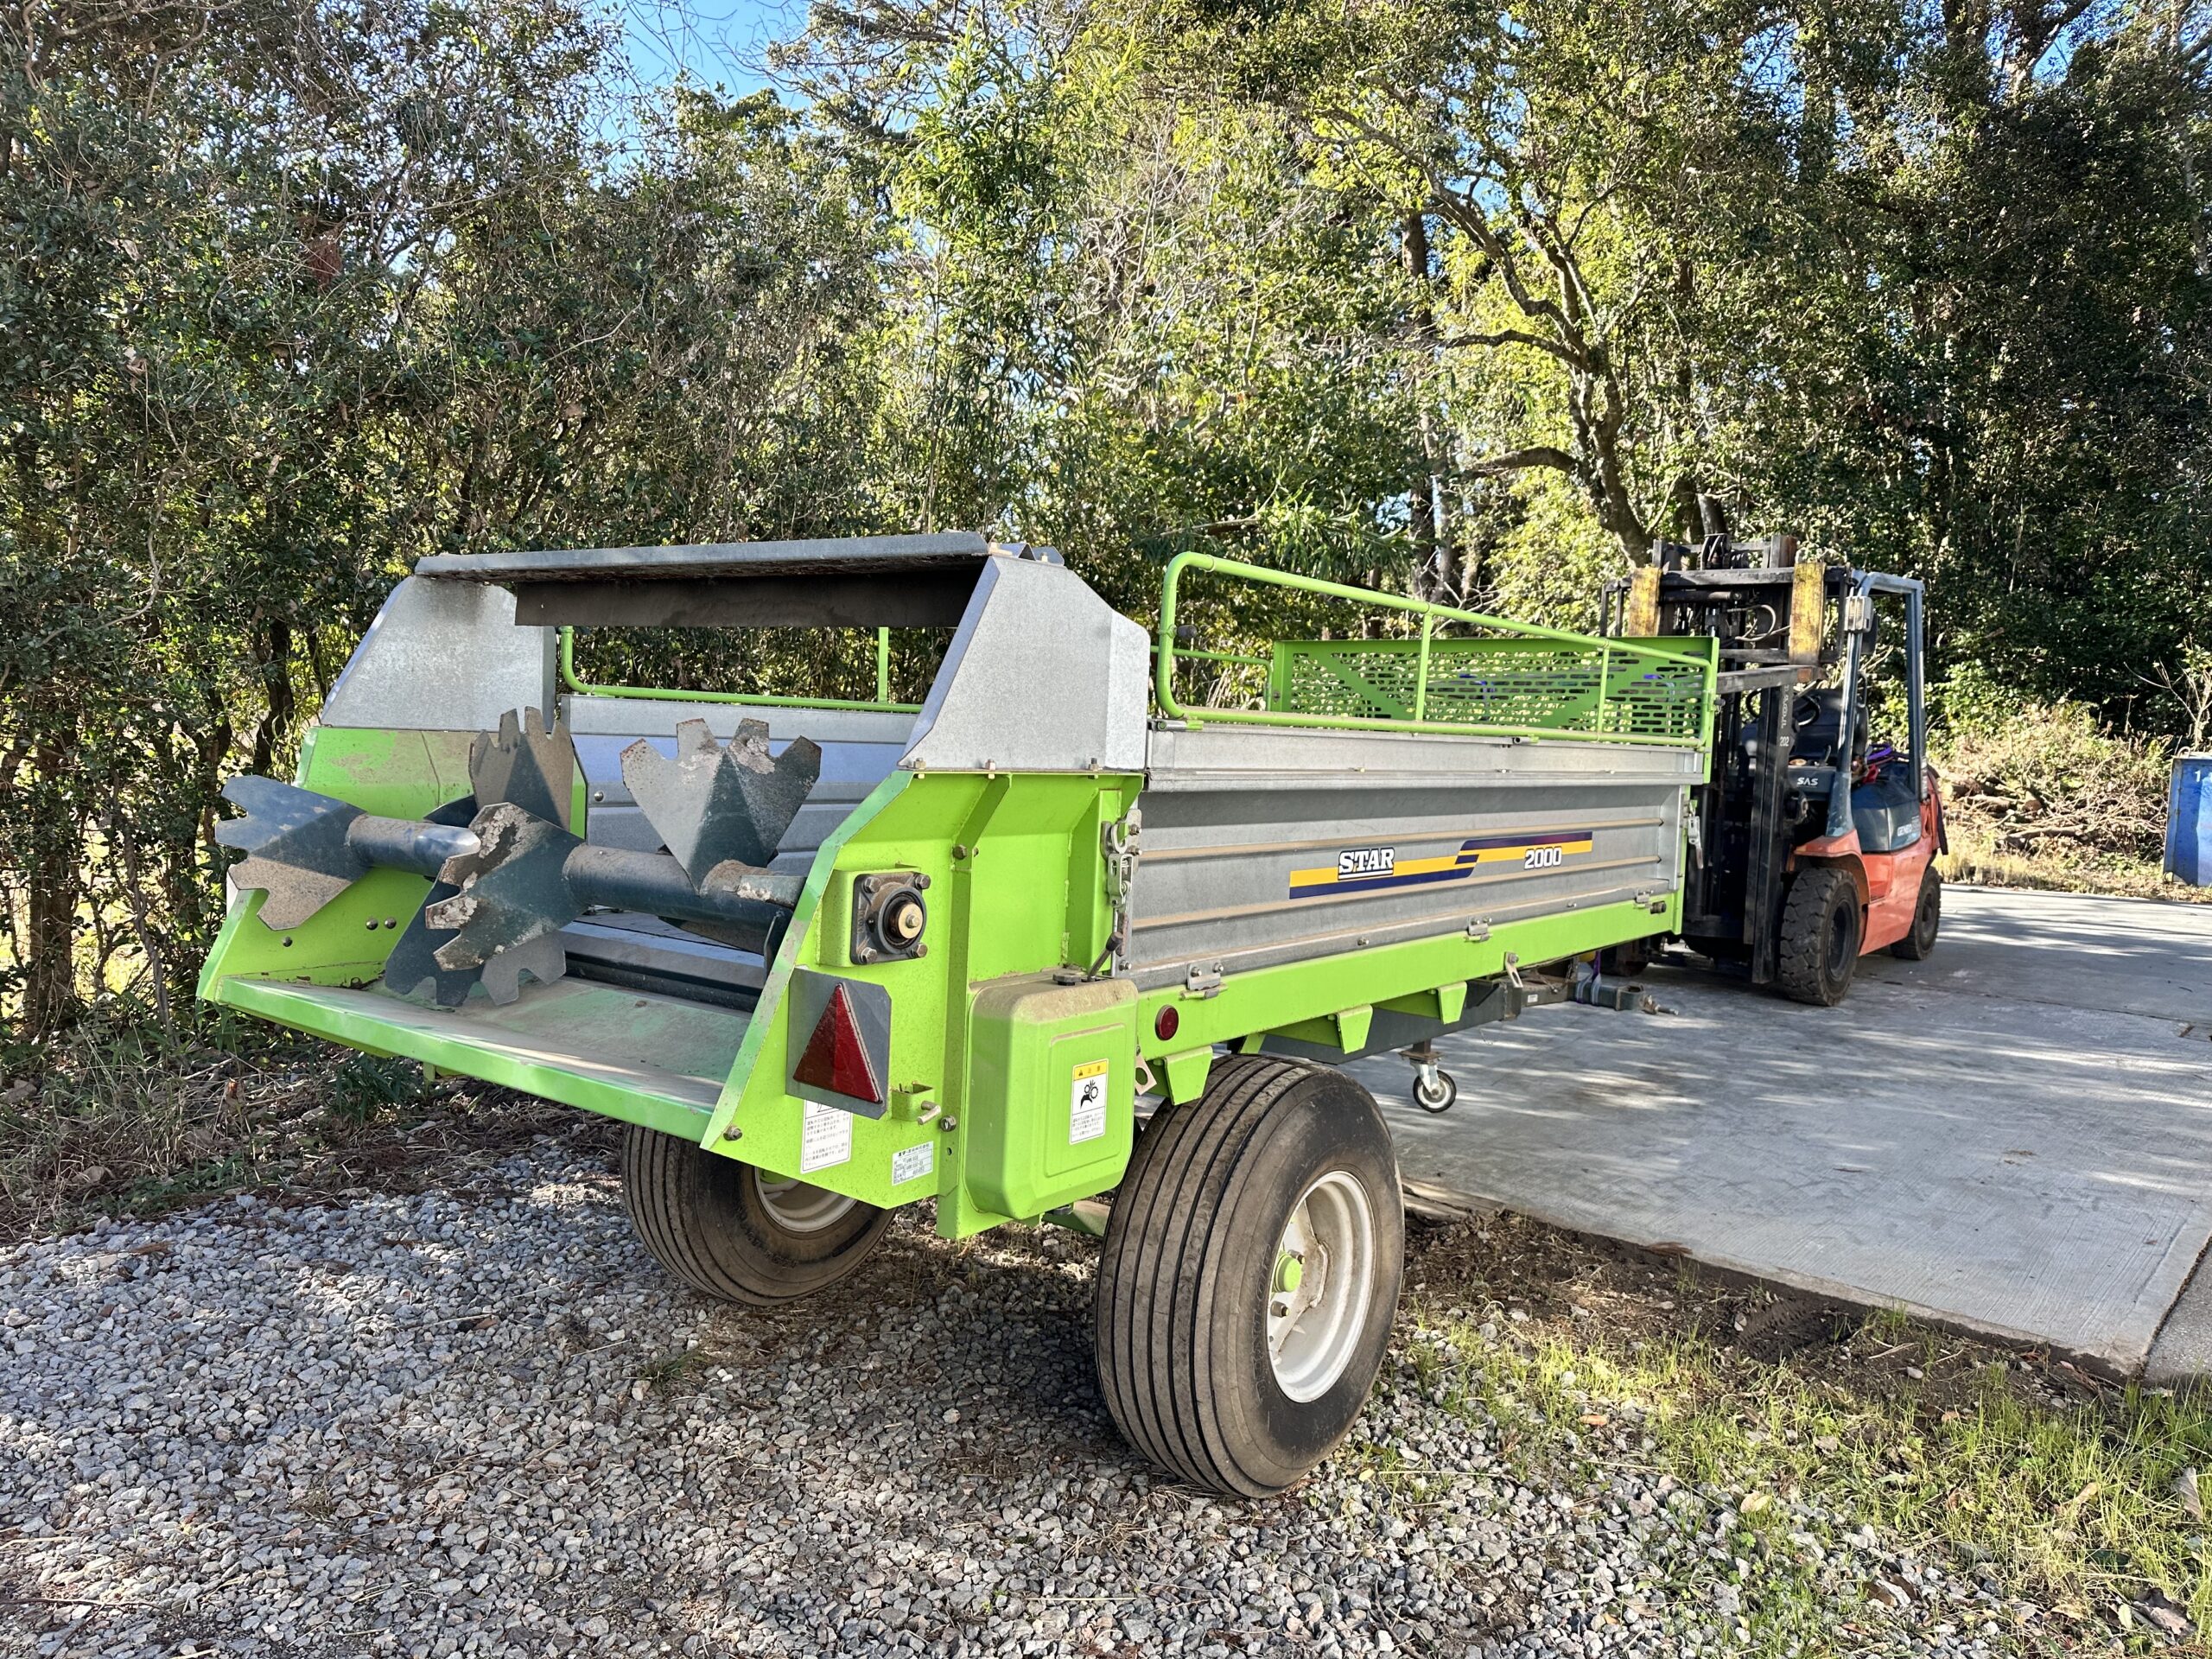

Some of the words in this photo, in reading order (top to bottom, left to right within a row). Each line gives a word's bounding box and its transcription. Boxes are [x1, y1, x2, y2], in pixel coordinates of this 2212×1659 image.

[1780, 736, 1789, 747] 202
[1338, 848, 1395, 875] STAR
[1524, 847, 1562, 869] 2000
